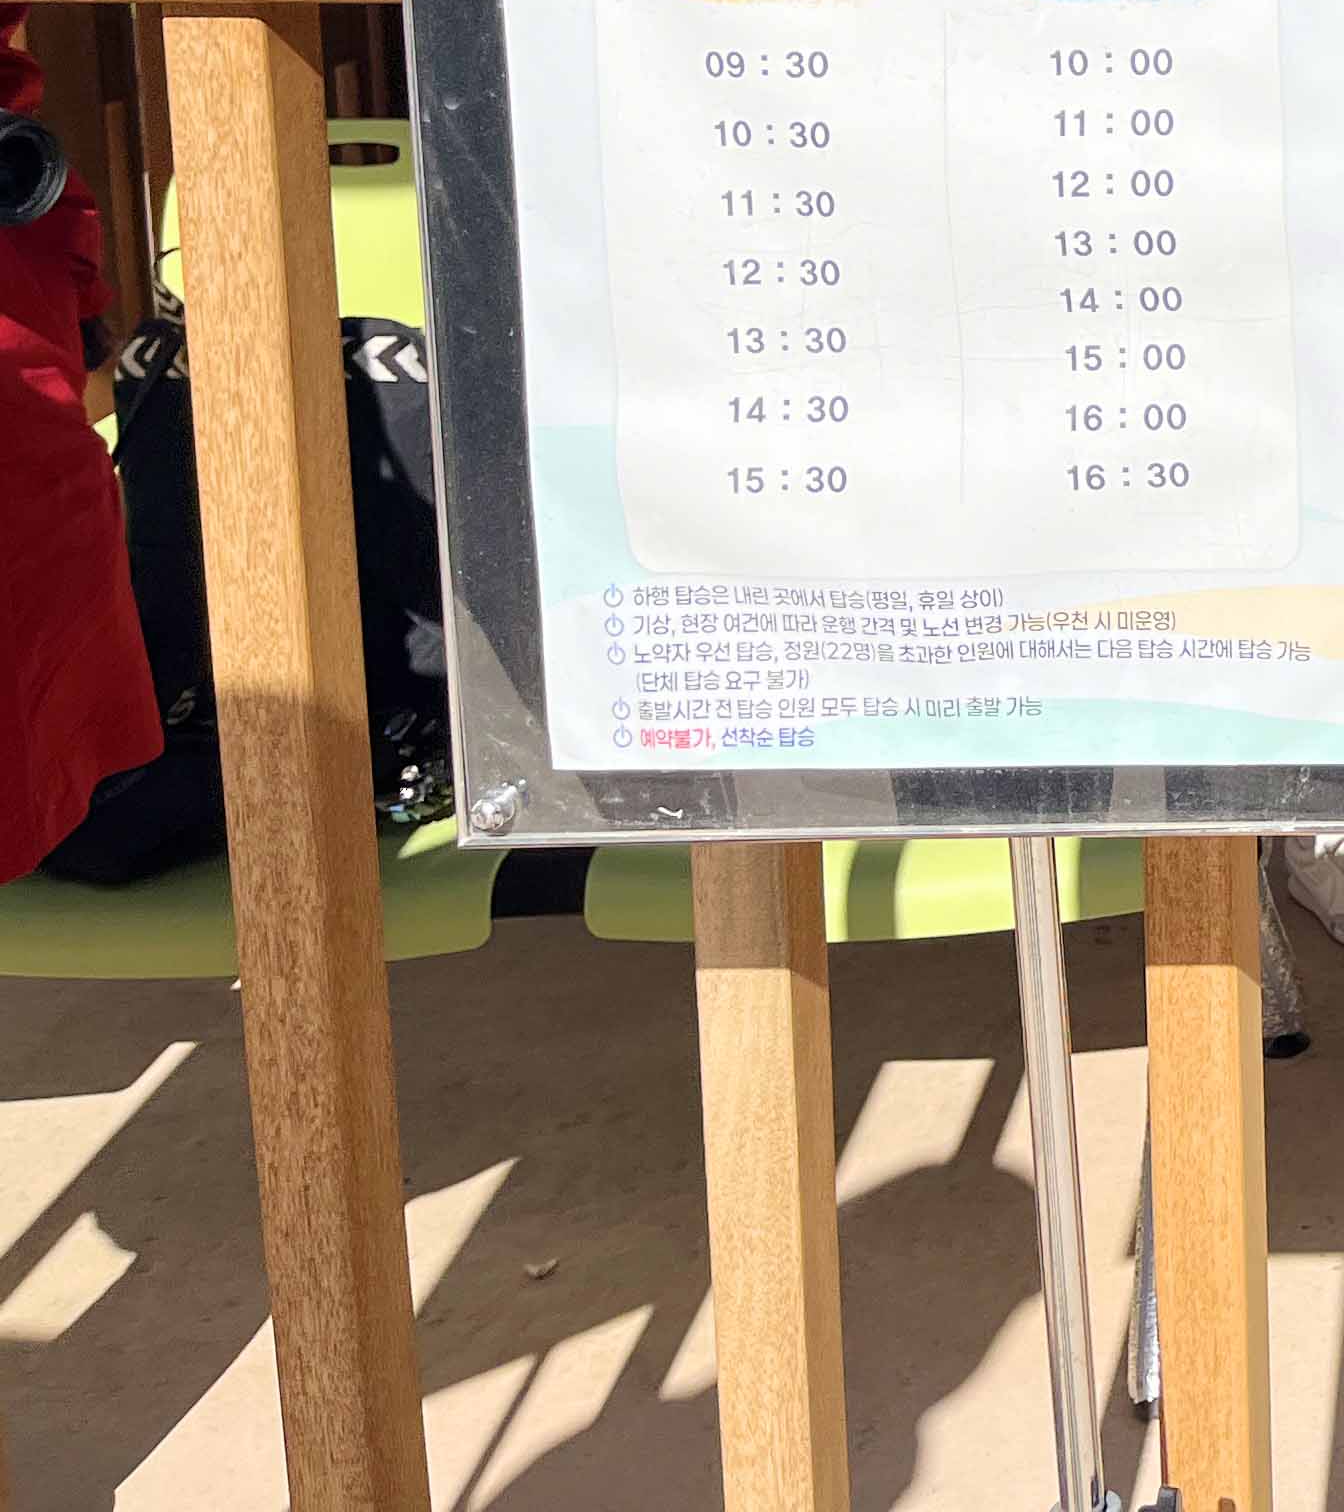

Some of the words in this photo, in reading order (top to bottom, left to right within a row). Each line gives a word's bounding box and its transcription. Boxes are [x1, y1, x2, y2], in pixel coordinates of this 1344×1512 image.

[632, 586, 670, 606] 하행
[676, 586, 729, 606] 탑승은
[734, 586, 769, 606] 내린
[773, 587, 826, 608] 곳에서
[830, 591, 913, 612] 탑승(평일,
[919, 591, 954, 609] 휴일
[960, 589, 1003, 609] 상이)
[632, 615, 676, 637] 기상,
[681, 614, 718, 633] 현장
[724, 614, 777, 633] 여건에
[783, 615, 818, 633] 따라
[822, 615, 856, 634] 운행
[861, 617, 895, 636] 간격
[900, 618, 917, 637] 및
[922, 612, 959, 635] 노선
[966, 616, 1002, 634] 변경
[1008, 611, 1088, 631] 가능(우천
[1094, 611, 1111, 630] 시
[1118, 611, 1176, 631] 미운영)
[634, 643, 690, 663] 노약자
[696, 643, 731, 662] 우선
[737, 642, 778, 663] 탑승,
[784, 642, 894, 662] 정원(22명)을
[899, 645, 952, 664] 초과한
[957, 643, 1014, 662] 인원에
[1020, 640, 1092, 659] 대해서는
[1098, 640, 1132, 659] 다음
[1139, 641, 1174, 659] 탑승
[1180, 639, 1233, 659] 시간에
[1239, 639, 1273, 659] 탑승
[1277, 641, 1311, 661] 가능
[636, 671, 678, 692] (단체
[685, 670, 720, 691] 탑승
[726, 671, 761, 691] 요구
[767, 670, 810, 690] 불가)
[639, 700, 710, 721] 출발시간
[716, 700, 733, 719] 전
[737, 700, 772, 719] 탑승
[778, 698, 815, 718] 인원
[821, 698, 857, 717] 모두
[863, 697, 898, 717] 탑승
[905, 698, 920, 718] 시
[924, 697, 960, 719] 미리
[967, 697, 1000, 717] 출발
[1006, 696, 1041, 716] 가능
[640, 728, 716, 750] 예약불가,
[722, 728, 773, 748] 선착순
[779, 727, 814, 748] 탑승
